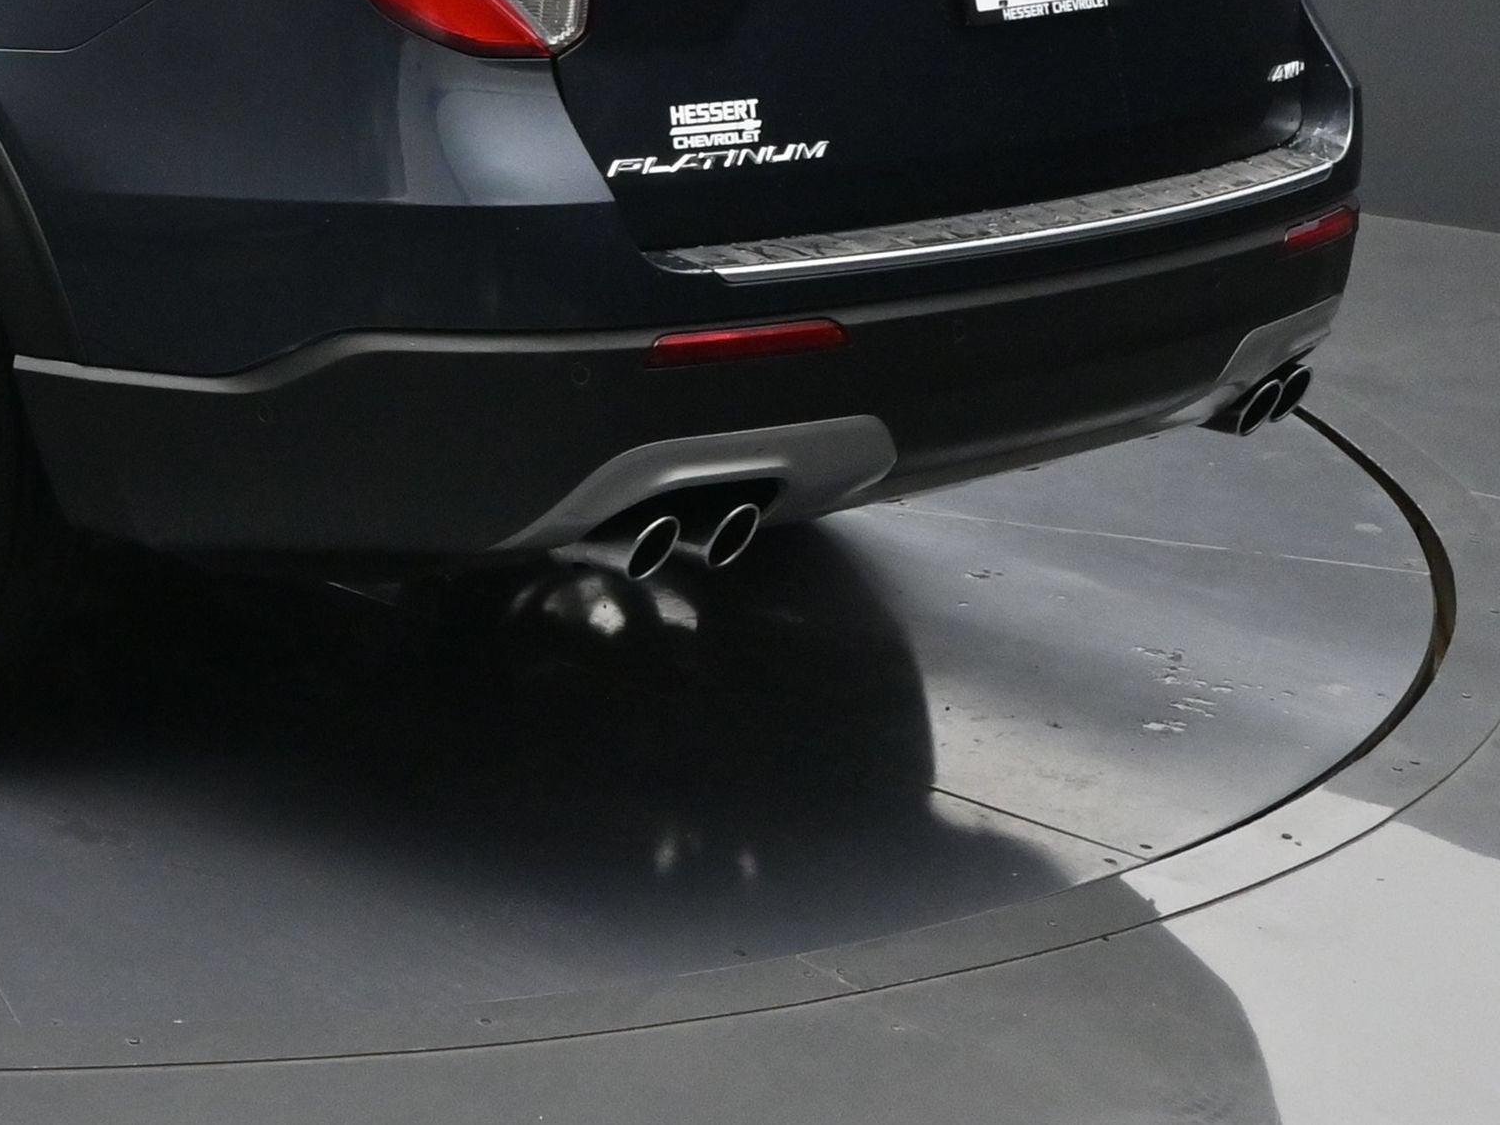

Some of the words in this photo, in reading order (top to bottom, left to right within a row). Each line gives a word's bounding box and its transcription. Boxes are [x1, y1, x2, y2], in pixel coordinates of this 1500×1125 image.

[1002, 3, 1050, 21] HESSERT
[669, 98, 759, 126] HESSERT
[673, 129, 761, 150] CHEVROLET
[607, 140, 830, 178] PLATINUM
